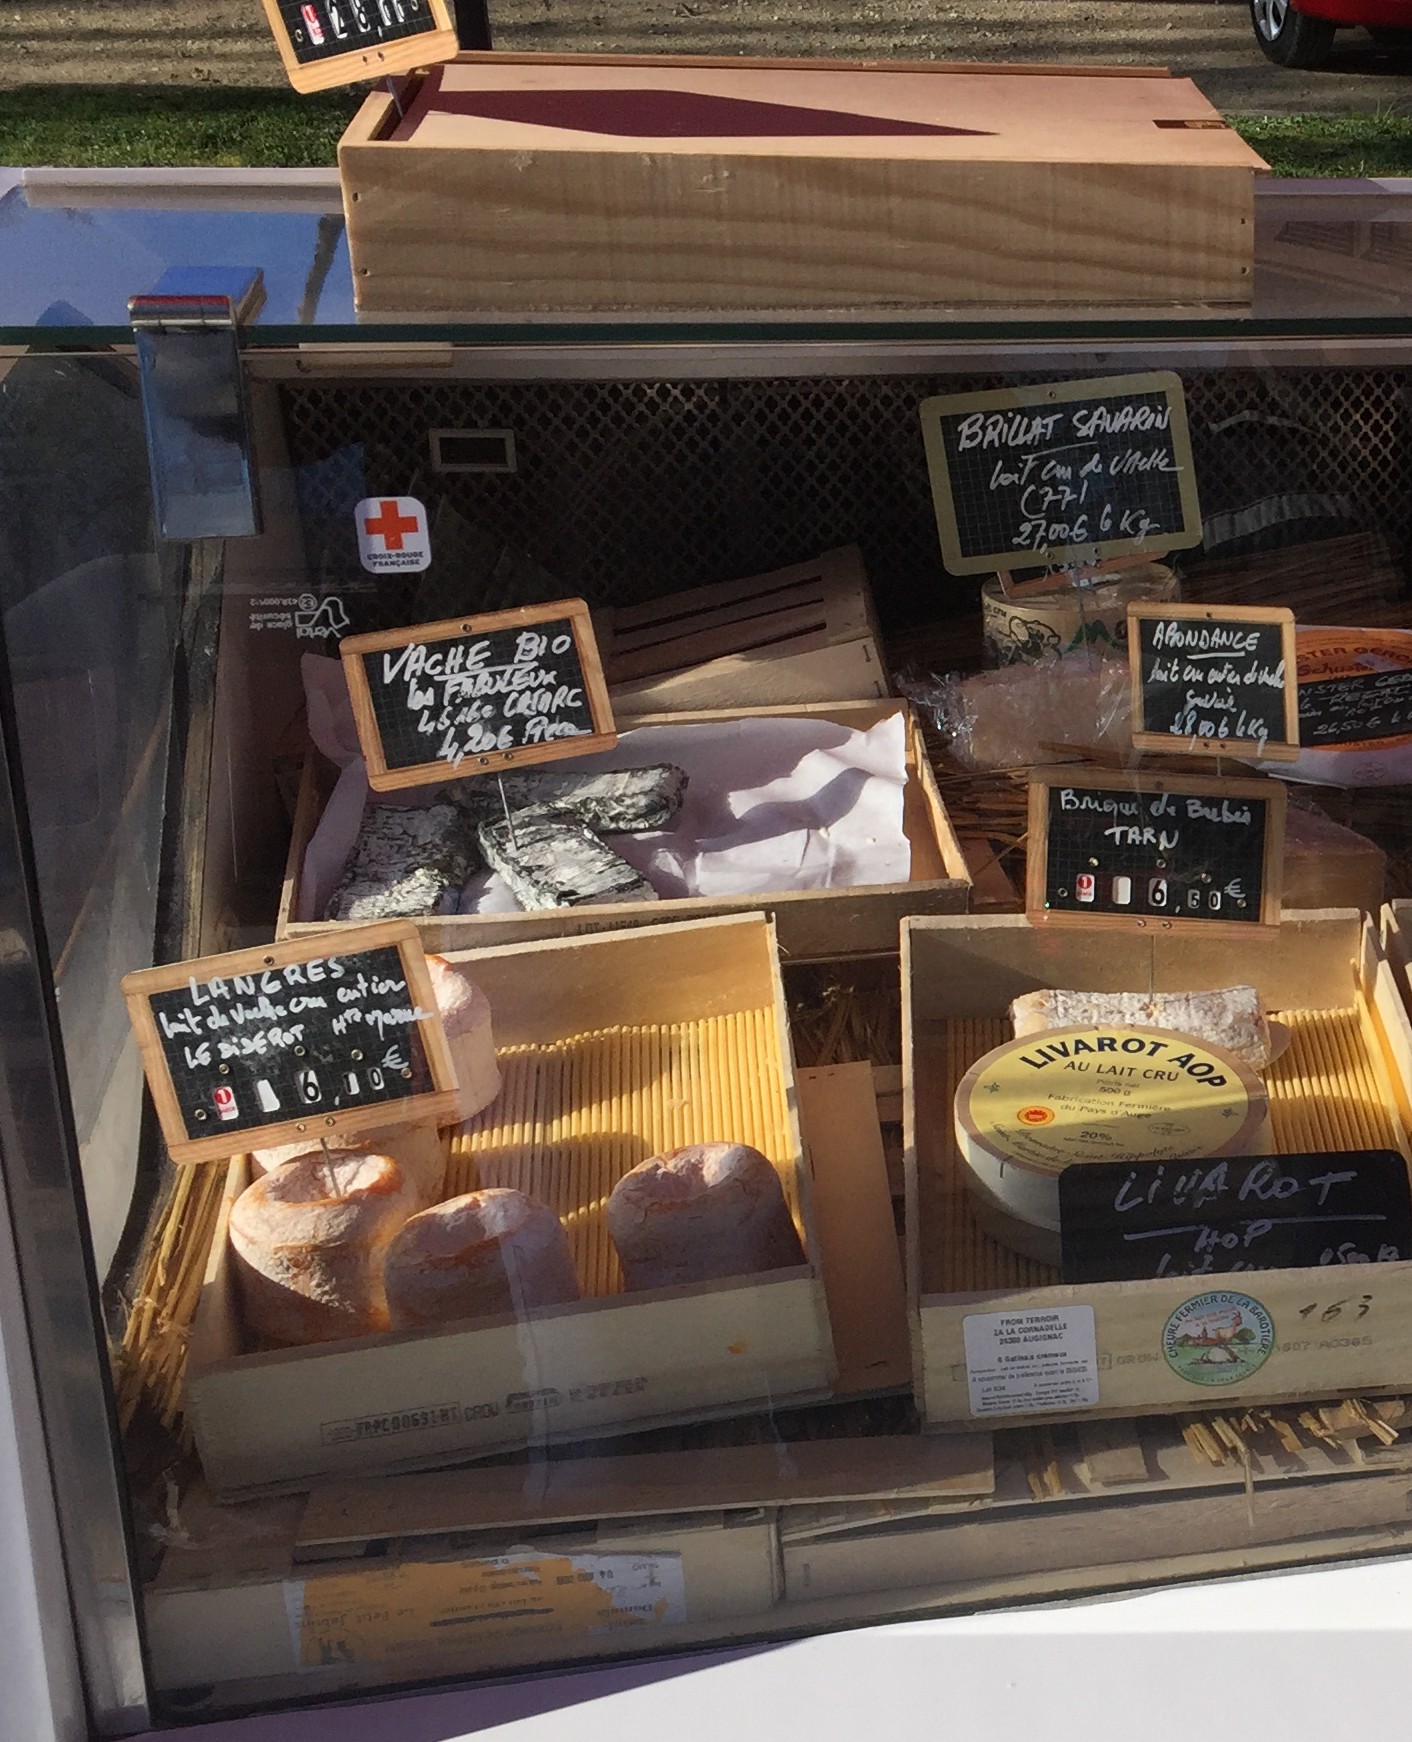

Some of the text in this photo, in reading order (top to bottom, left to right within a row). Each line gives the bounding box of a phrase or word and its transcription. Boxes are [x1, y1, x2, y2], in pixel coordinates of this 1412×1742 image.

[366, 551, 424, 561] CROIX-ROUGE
[1152, 622, 1261, 651] ABONDANCE
[383, 631, 571, 684] VACHE BIO
[1296, 646, 1347, 663] STER
[1298, 678, 1365, 697] NSTER
[1104, 825, 1180, 850] TARN
[1223, 878, 1246, 898] €
[189, 956, 345, 1006] LANGRES
[382, 1045, 409, 1069] €
[1020, 1037, 1228, 1090] LIVAROT AOP
[1064, 1061, 1180, 1083] AU LAIT CRU
[1047, 1093, 1116, 1107] Fabrication
[1060, 1104, 1076, 1112] du
[1078, 1105, 1108, 1116] Pays
[1176, 1294, 1219, 1324] FERMIER
[1219, 1293, 1235, 1305] DE
[1236, 1297, 1251, 1309] LA
